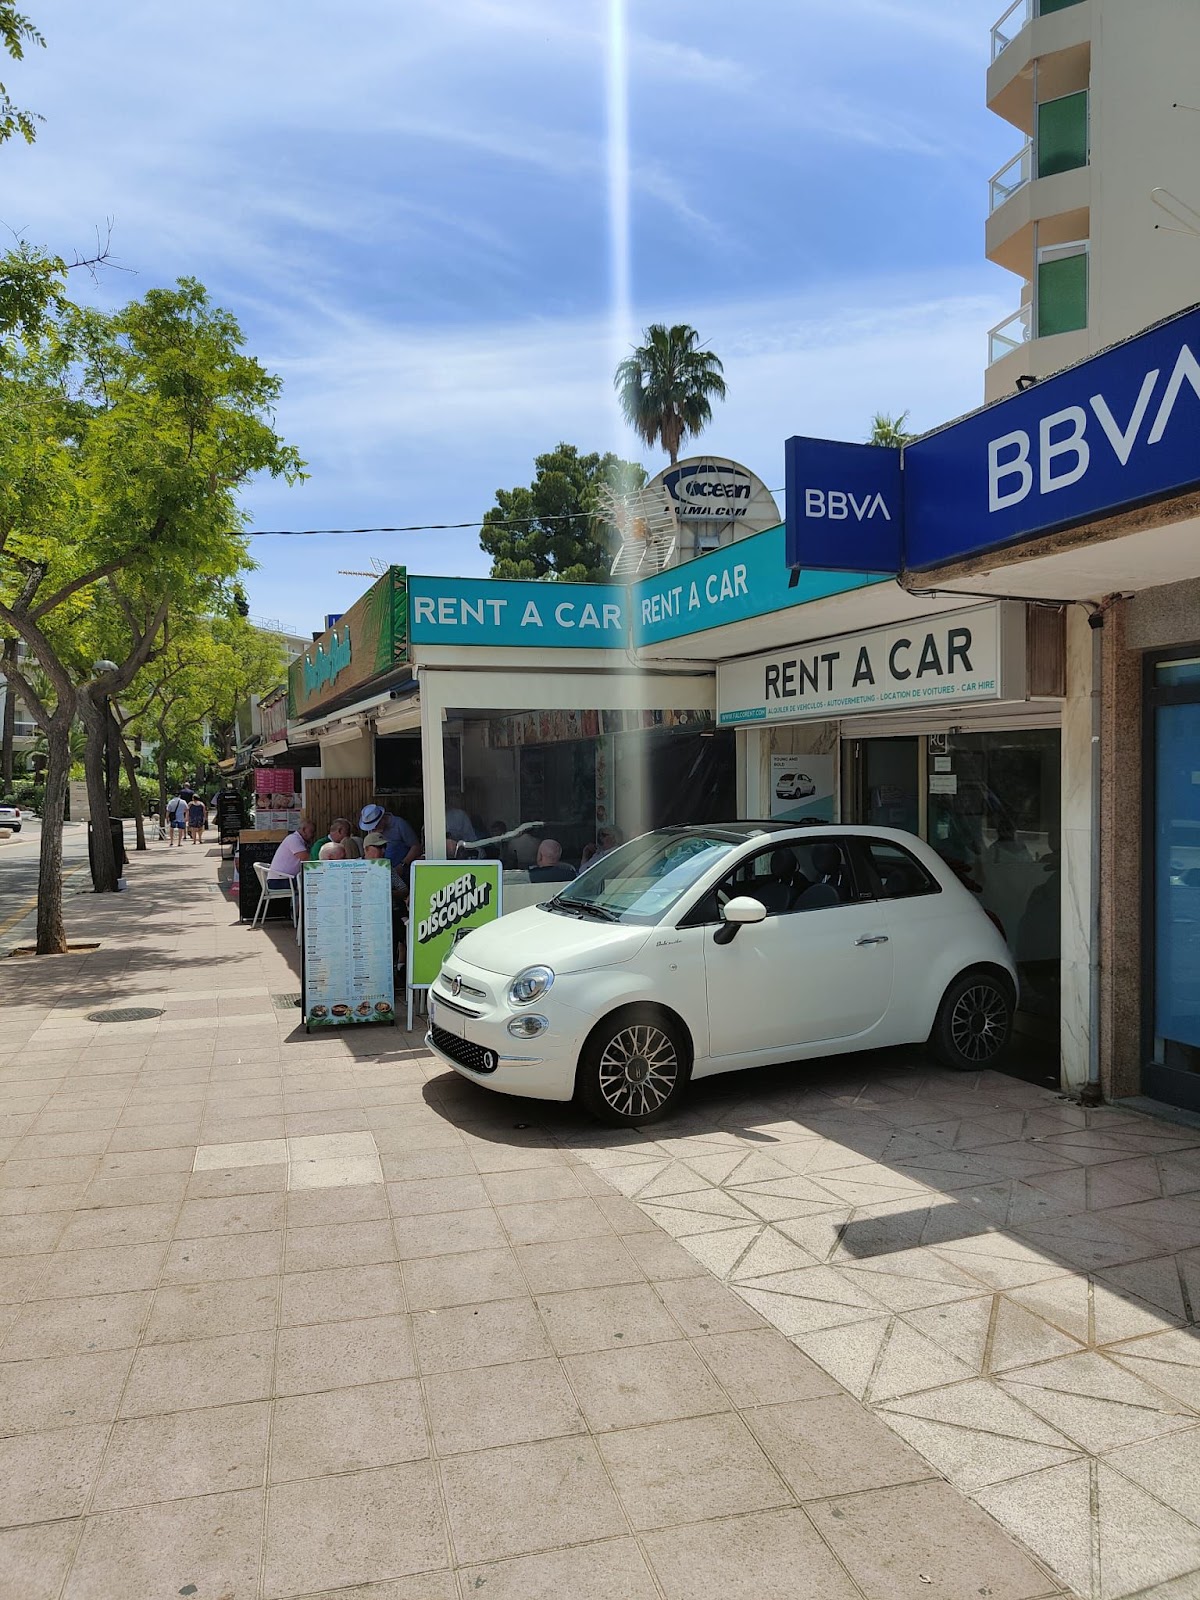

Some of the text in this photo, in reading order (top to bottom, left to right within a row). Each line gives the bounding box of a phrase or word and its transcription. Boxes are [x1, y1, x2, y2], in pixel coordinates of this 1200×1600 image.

[987, 343, 1200, 513] BBVA
[804, 487, 891, 521] BBVA
[414, 596, 622, 630] RENT A CAR
[641, 564, 748, 626] RENT A CAR
[765, 627, 973, 700] RENT A CAR
[880, 690, 911, 701] LOCATION
[912, 689, 921, 698] DE
[922, 685, 955, 696] VOITURES
[961, 682, 977, 692] CAR
[978, 680, 995, 689] HIRE
[417, 882, 490, 943] DISCOUNT
[429, 873, 472, 912] SUPER
